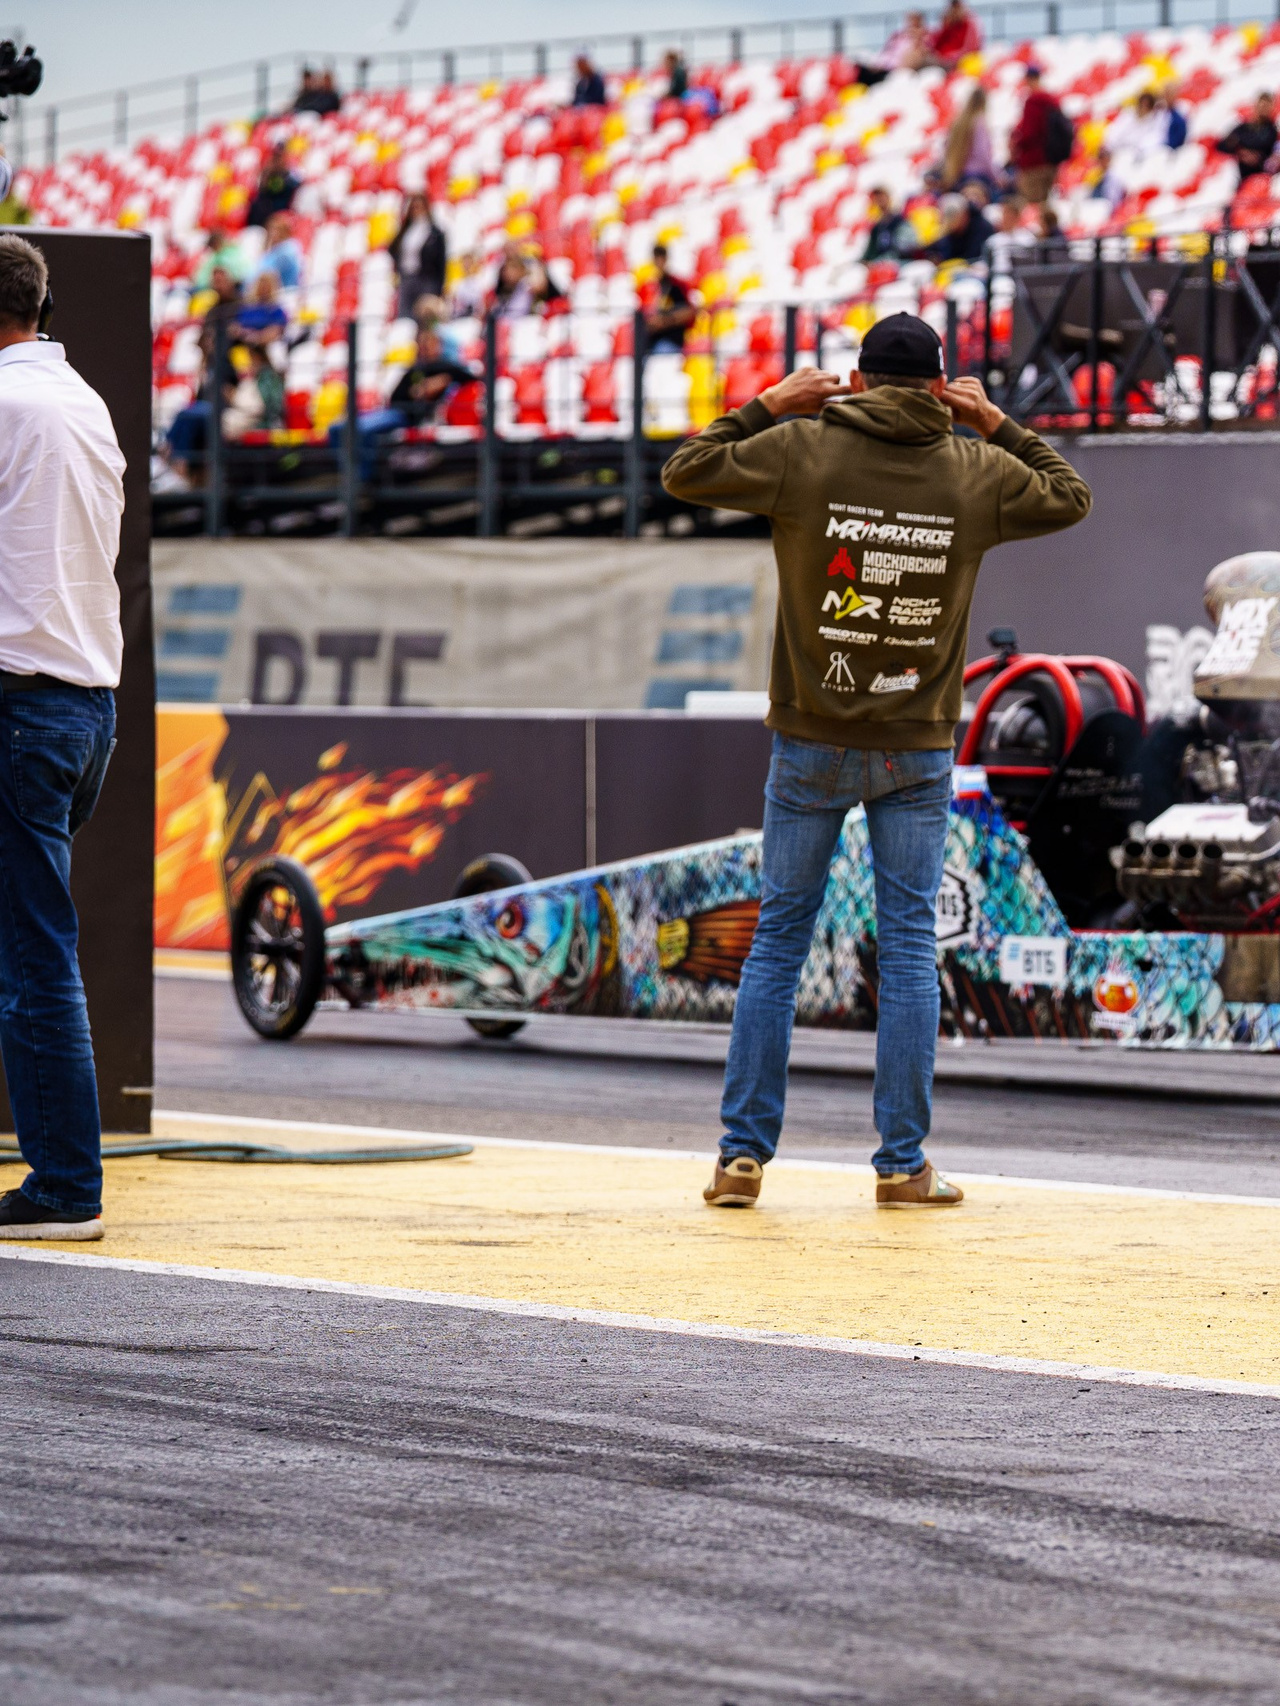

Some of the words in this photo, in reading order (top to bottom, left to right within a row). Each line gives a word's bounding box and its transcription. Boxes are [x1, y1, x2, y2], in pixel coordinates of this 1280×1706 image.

[862, 550, 948, 574] МОСКОВСКИЙ
[861, 566, 903, 587] СПОРТ
[892, 596, 940, 607] NIGHT
[889, 605, 942, 617] RACER
[887, 614, 933, 626] TEAM
